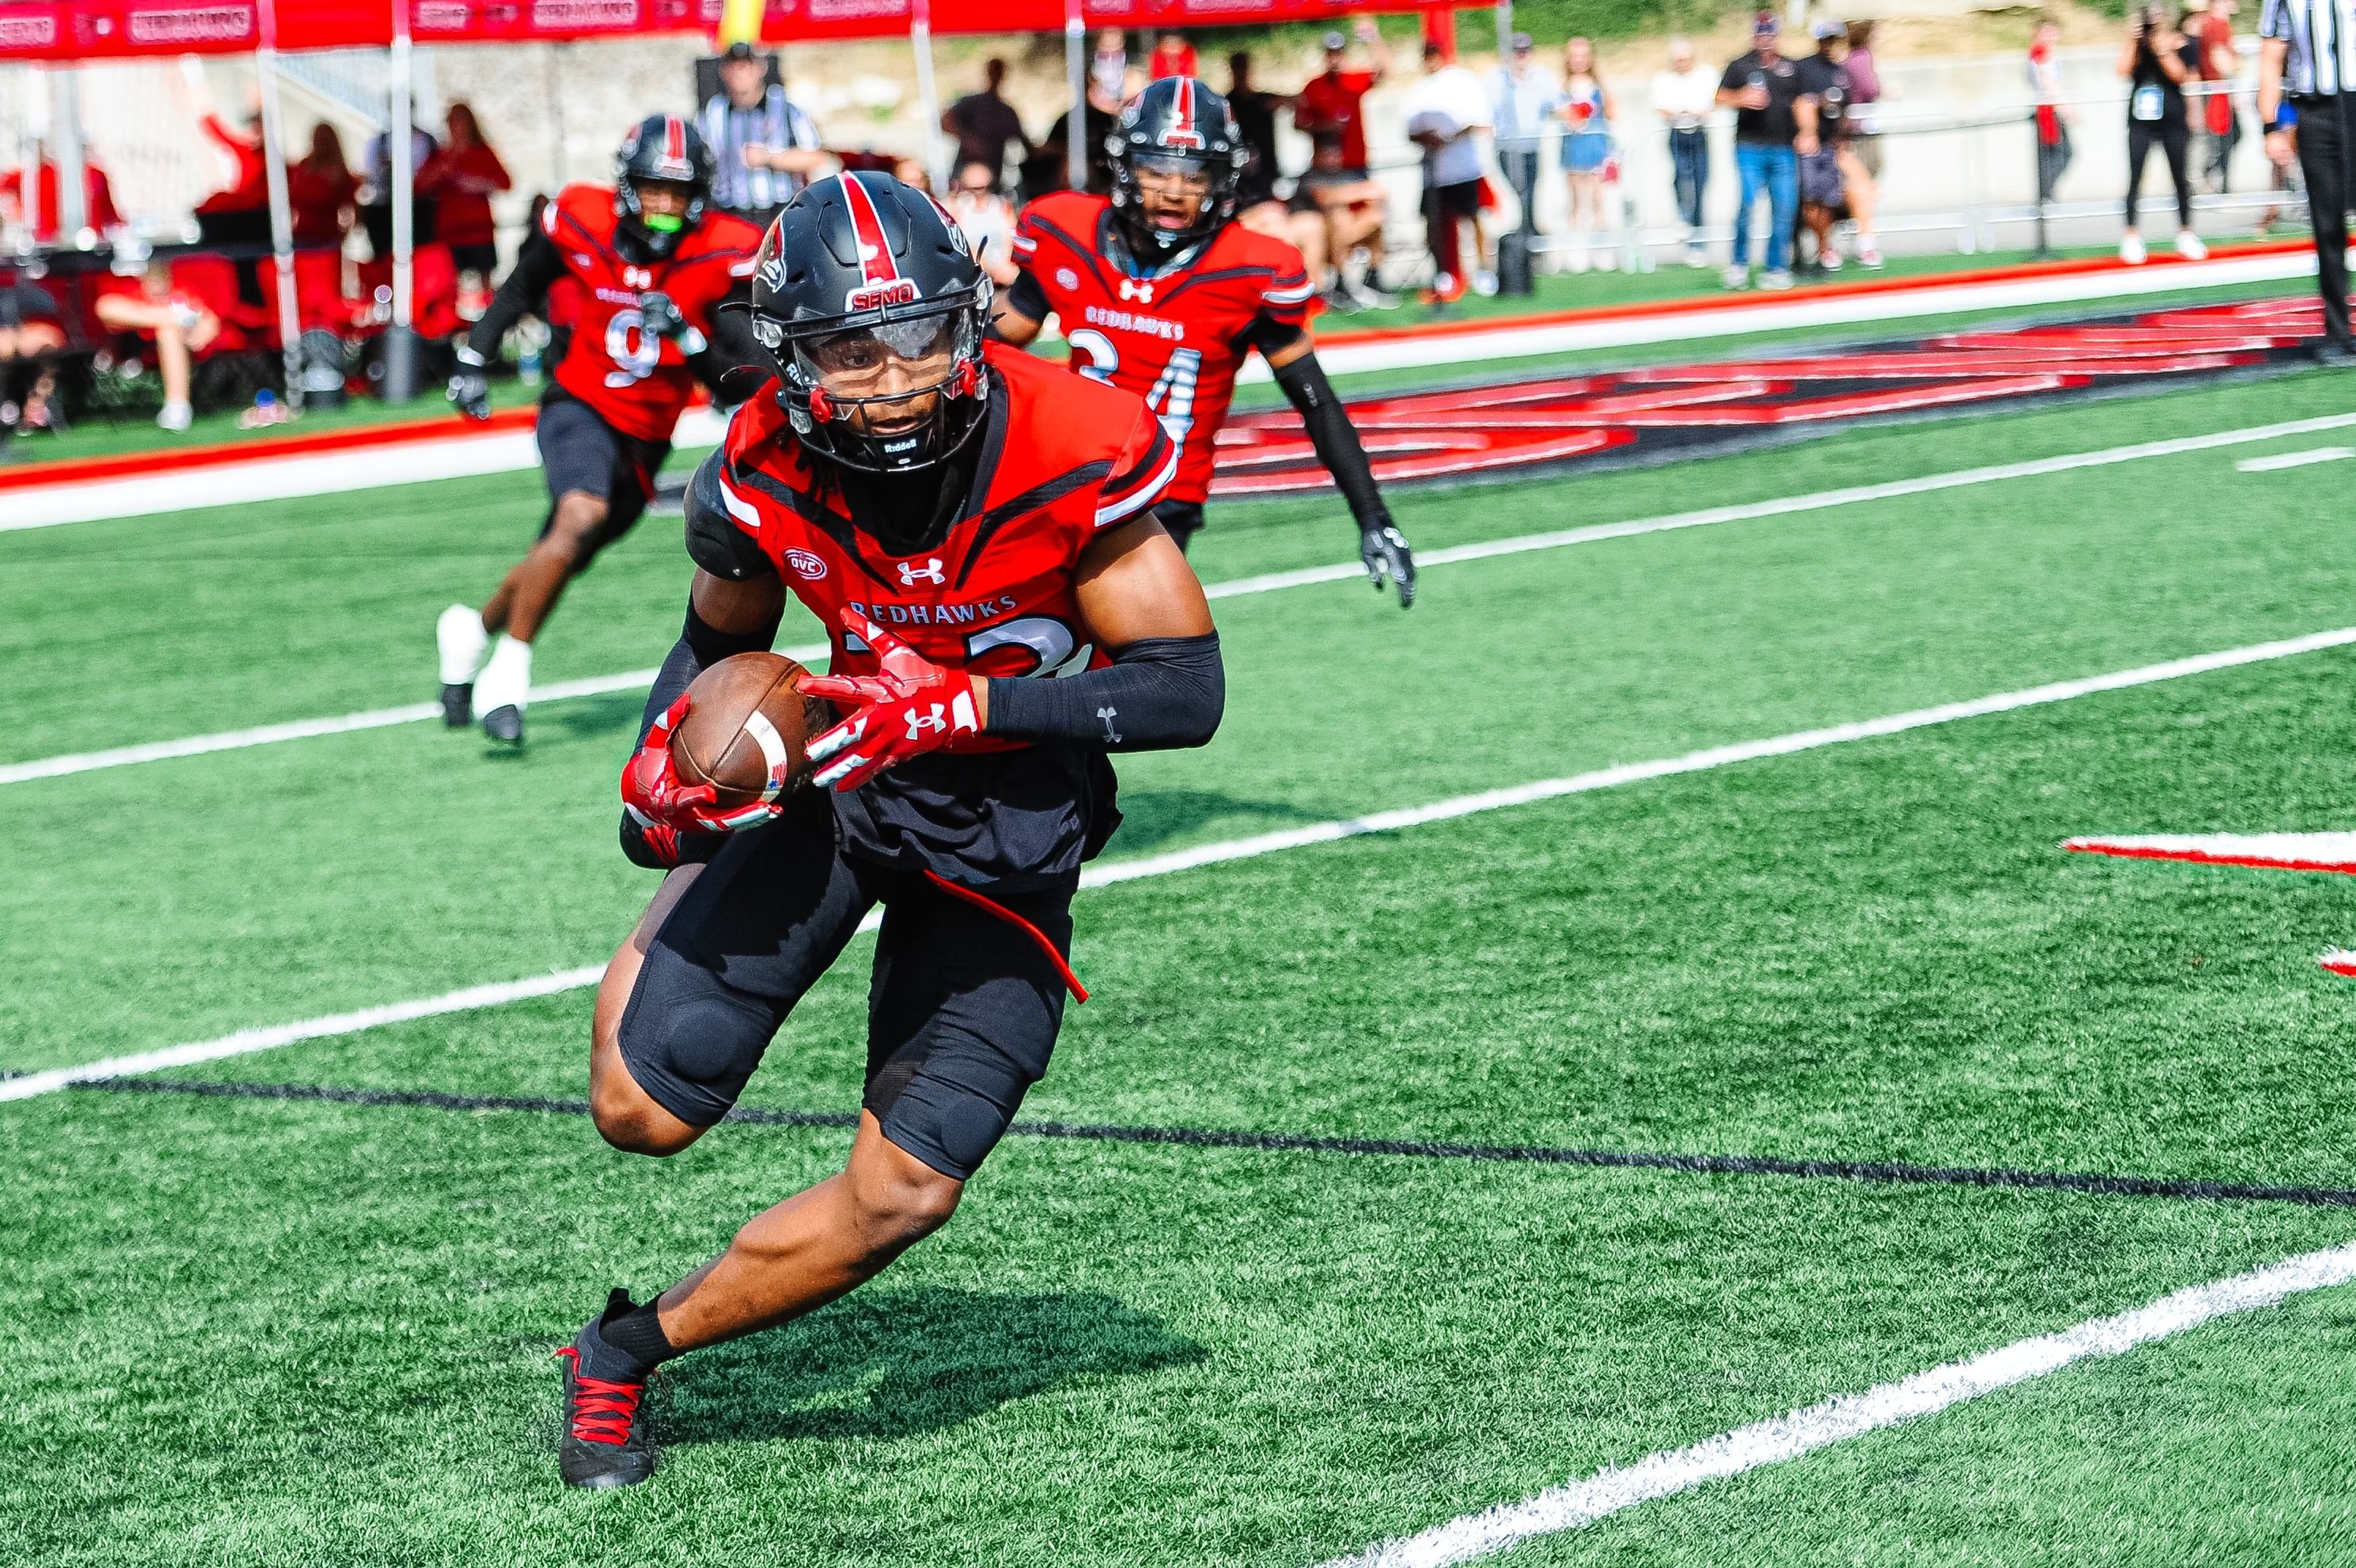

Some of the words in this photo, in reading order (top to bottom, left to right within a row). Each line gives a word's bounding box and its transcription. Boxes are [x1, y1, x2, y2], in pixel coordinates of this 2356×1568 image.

[852, 283, 914, 310] SEMO
[604, 309, 661, 388] 9
[791, 557, 816, 573] OVC
[850, 595, 1017, 625] REDHAWKS
